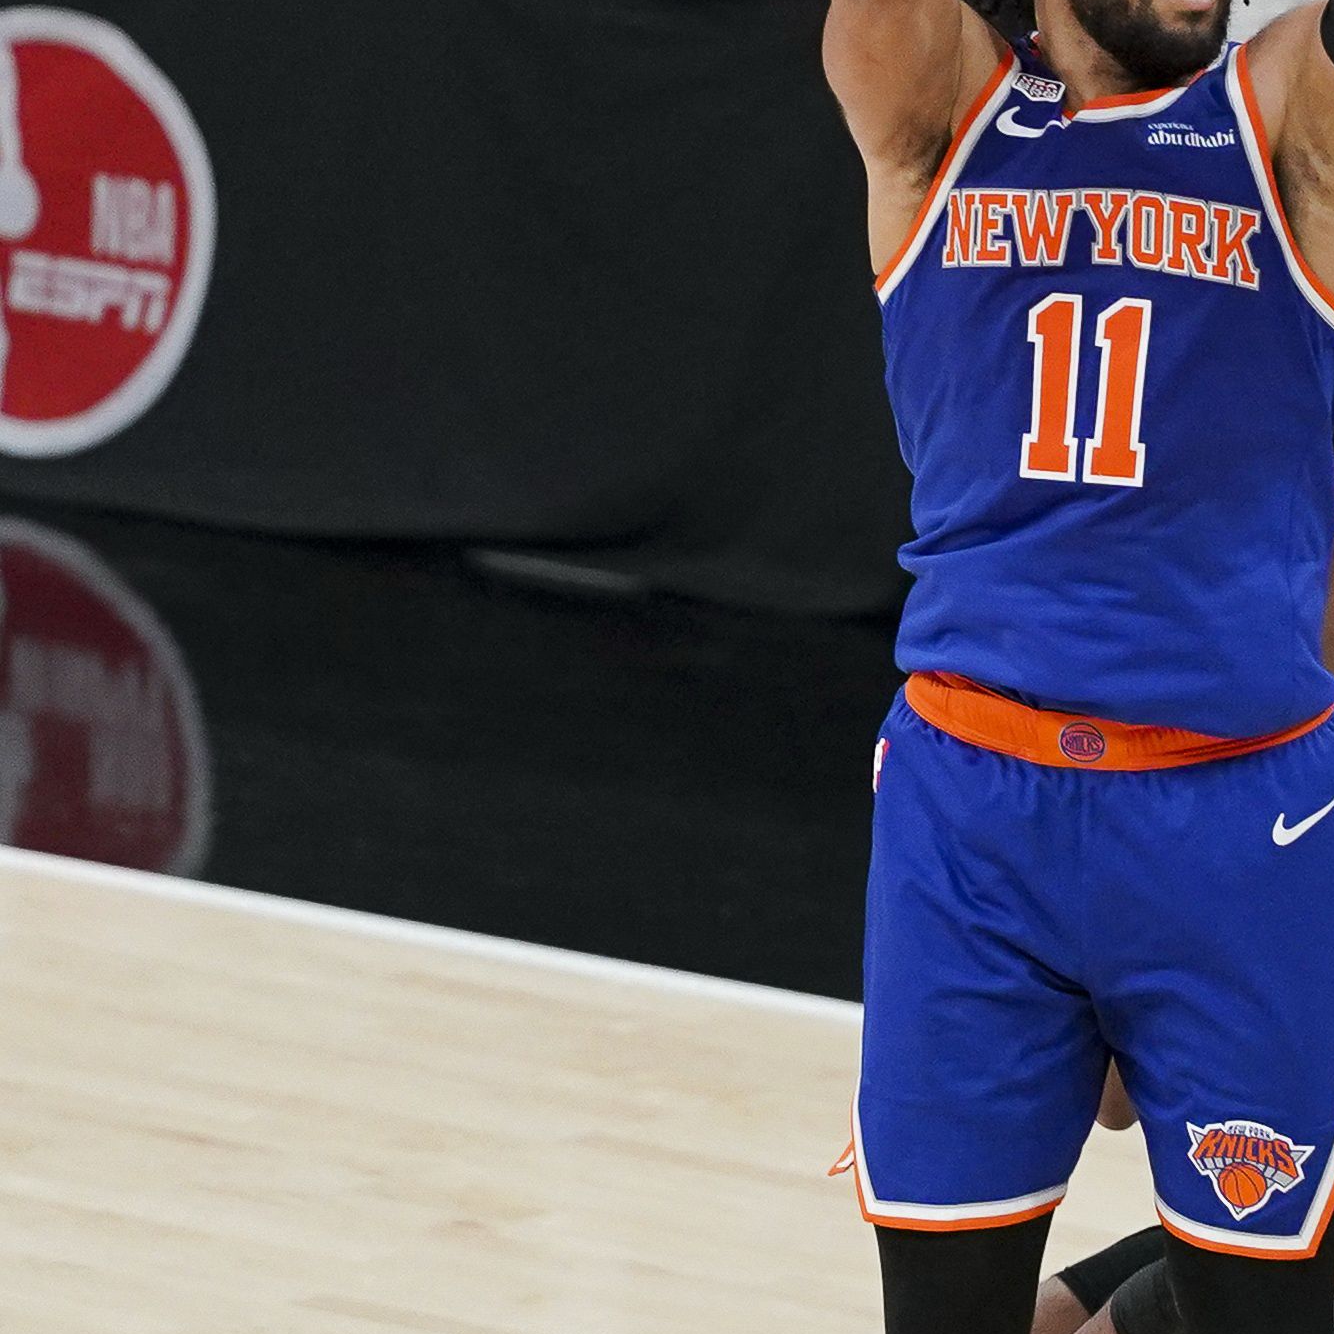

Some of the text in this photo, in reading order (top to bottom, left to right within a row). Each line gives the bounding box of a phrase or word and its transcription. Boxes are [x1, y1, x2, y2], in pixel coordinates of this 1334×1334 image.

[1147, 128, 1235, 148] abu dhabi
[942, 188, 1261, 291] NEW YORK
[1019, 292, 1152, 488] 11
[1192, 1128, 1299, 1180] KNICKS
